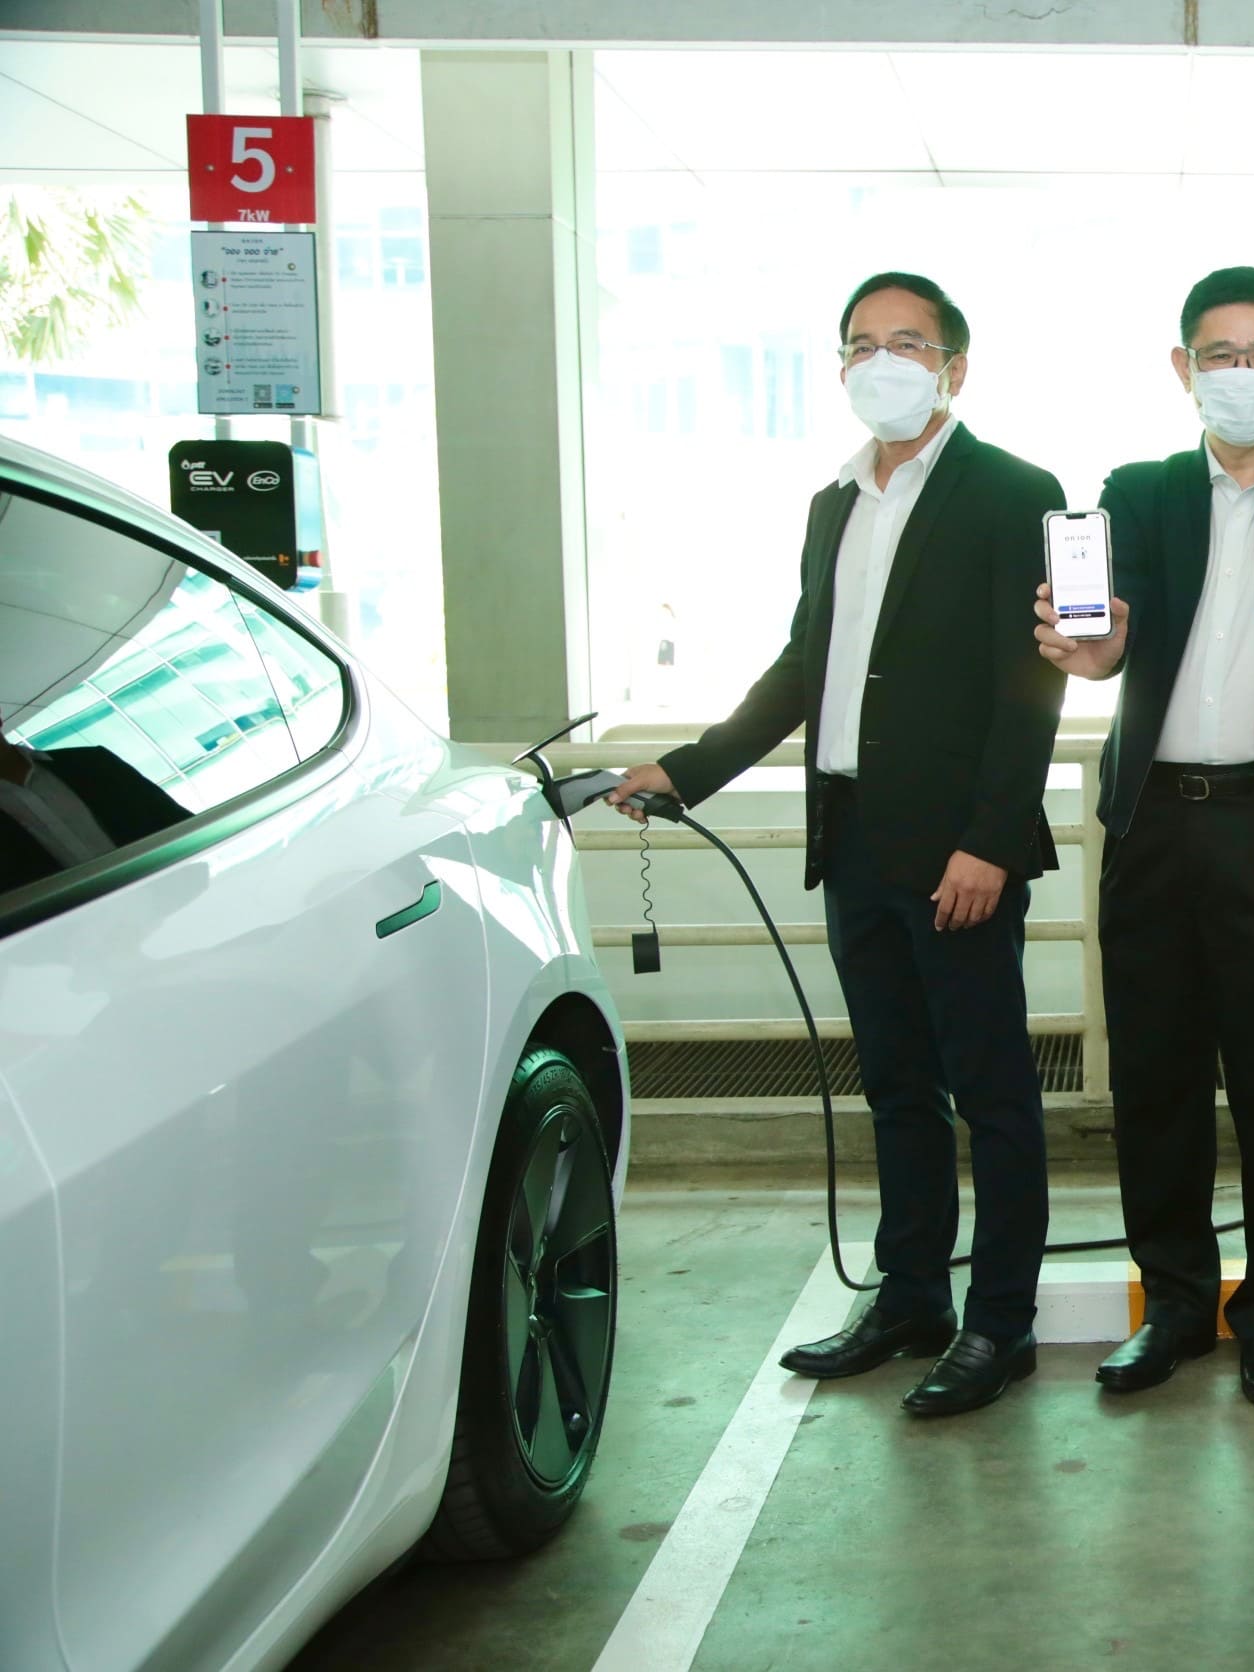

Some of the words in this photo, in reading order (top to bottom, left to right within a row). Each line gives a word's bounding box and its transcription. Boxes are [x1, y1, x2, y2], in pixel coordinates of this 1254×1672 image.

[230, 126, 276, 193] 5
[237, 209, 270, 222] 7kW
[189, 470, 235, 486] EV
